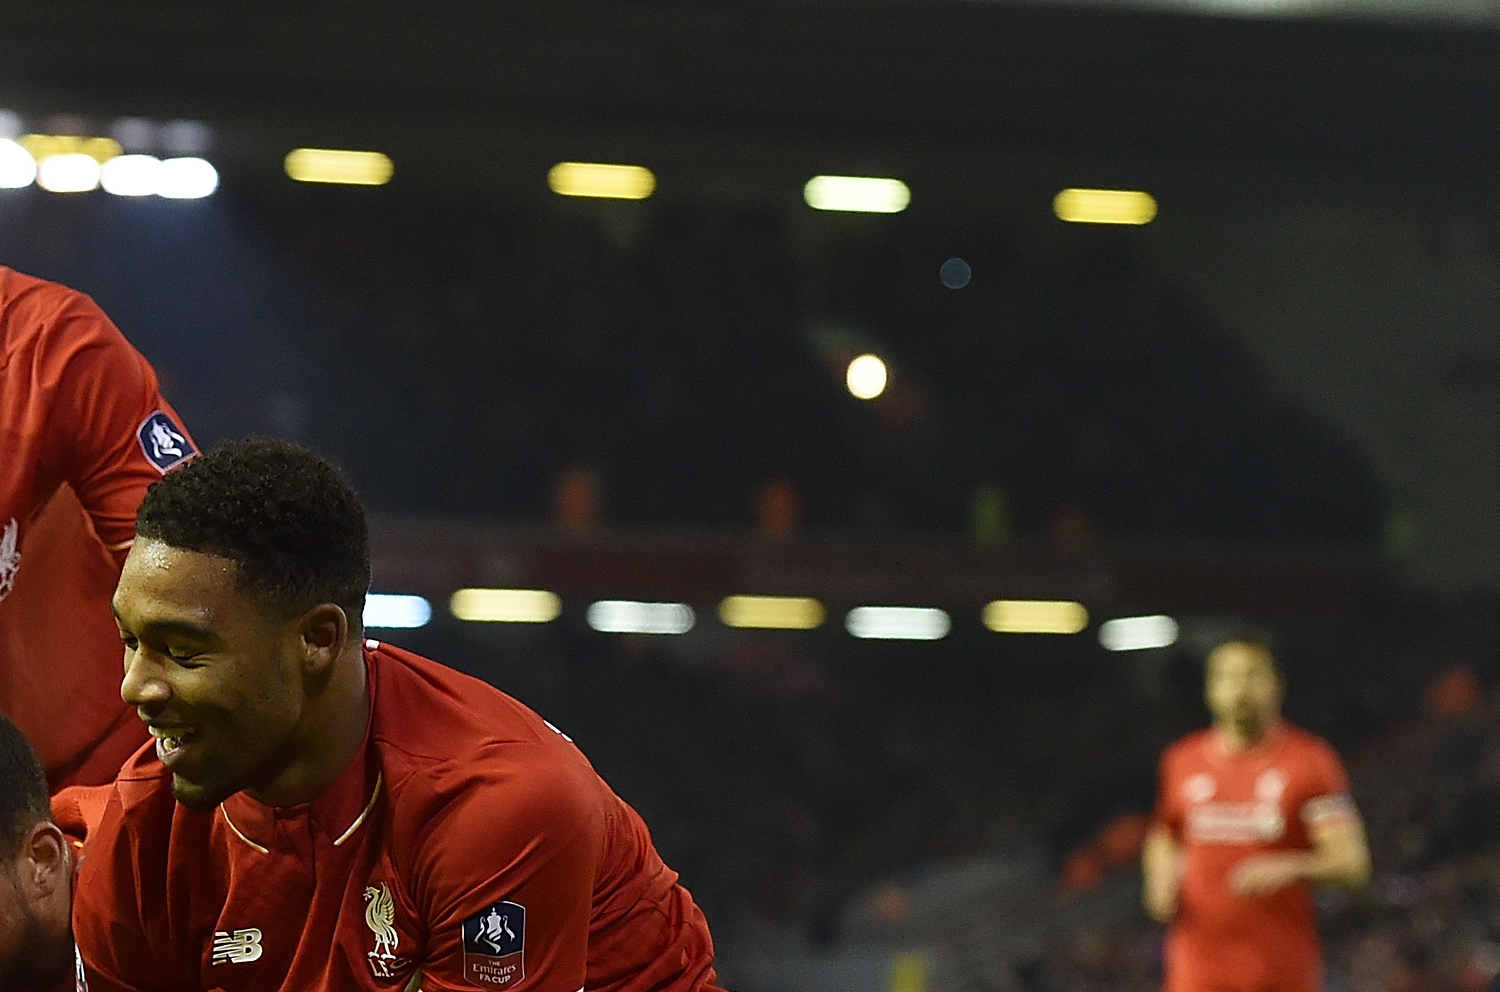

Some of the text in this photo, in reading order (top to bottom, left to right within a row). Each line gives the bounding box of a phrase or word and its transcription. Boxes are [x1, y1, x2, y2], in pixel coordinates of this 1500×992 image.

[473, 963, 517, 976] Emirates
[479, 973, 511, 984] FA CUP
